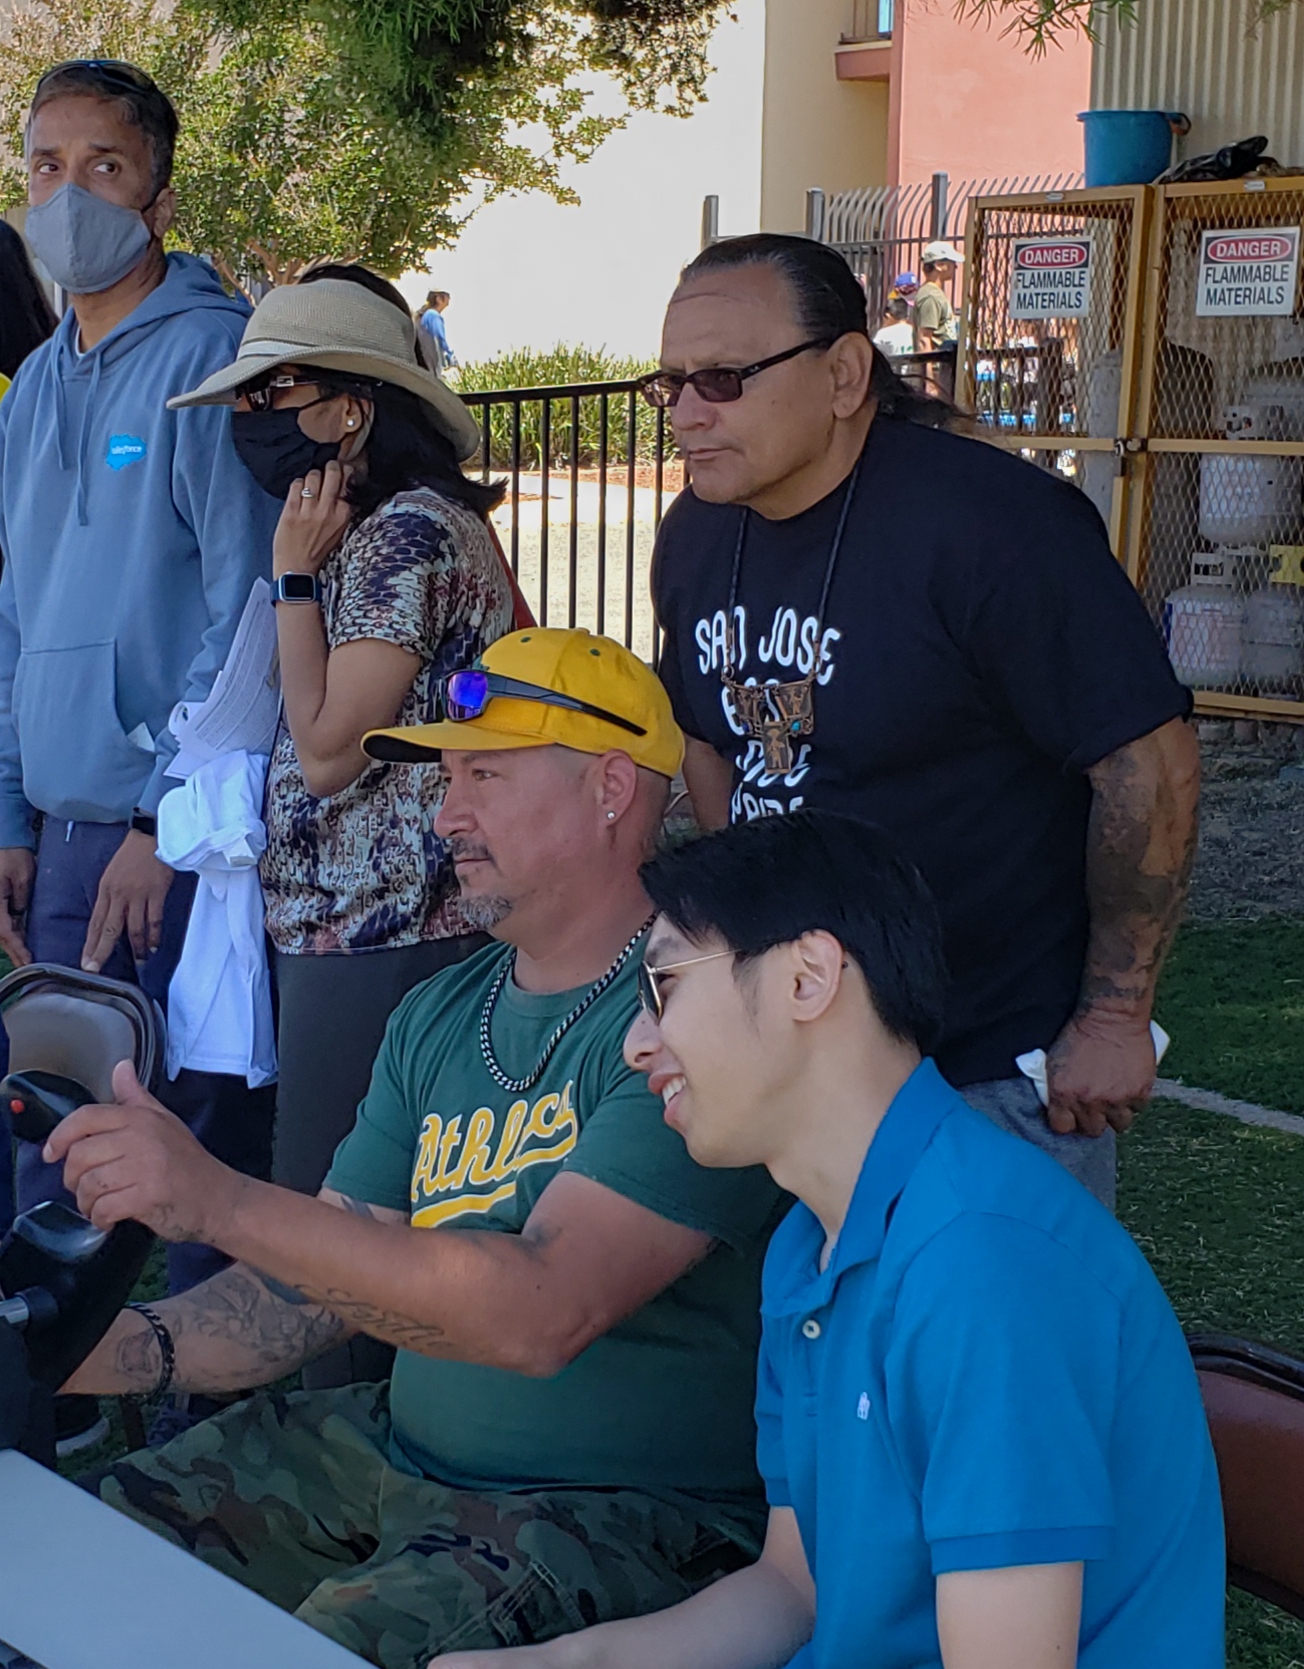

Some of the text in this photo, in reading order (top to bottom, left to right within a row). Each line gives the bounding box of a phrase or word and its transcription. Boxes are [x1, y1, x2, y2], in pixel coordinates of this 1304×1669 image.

[1024, 248, 1079, 264] DANGER
[1215, 240, 1281, 258] DANGER
[1015, 270, 1086, 289] FLAMMABLE
[1204, 264, 1290, 285] FLAMMABLE
[1015, 292, 1083, 310] MATERIALS
[1205, 286, 1285, 306] MATERIALS
[695, 606, 841, 685] SAN JOSE
